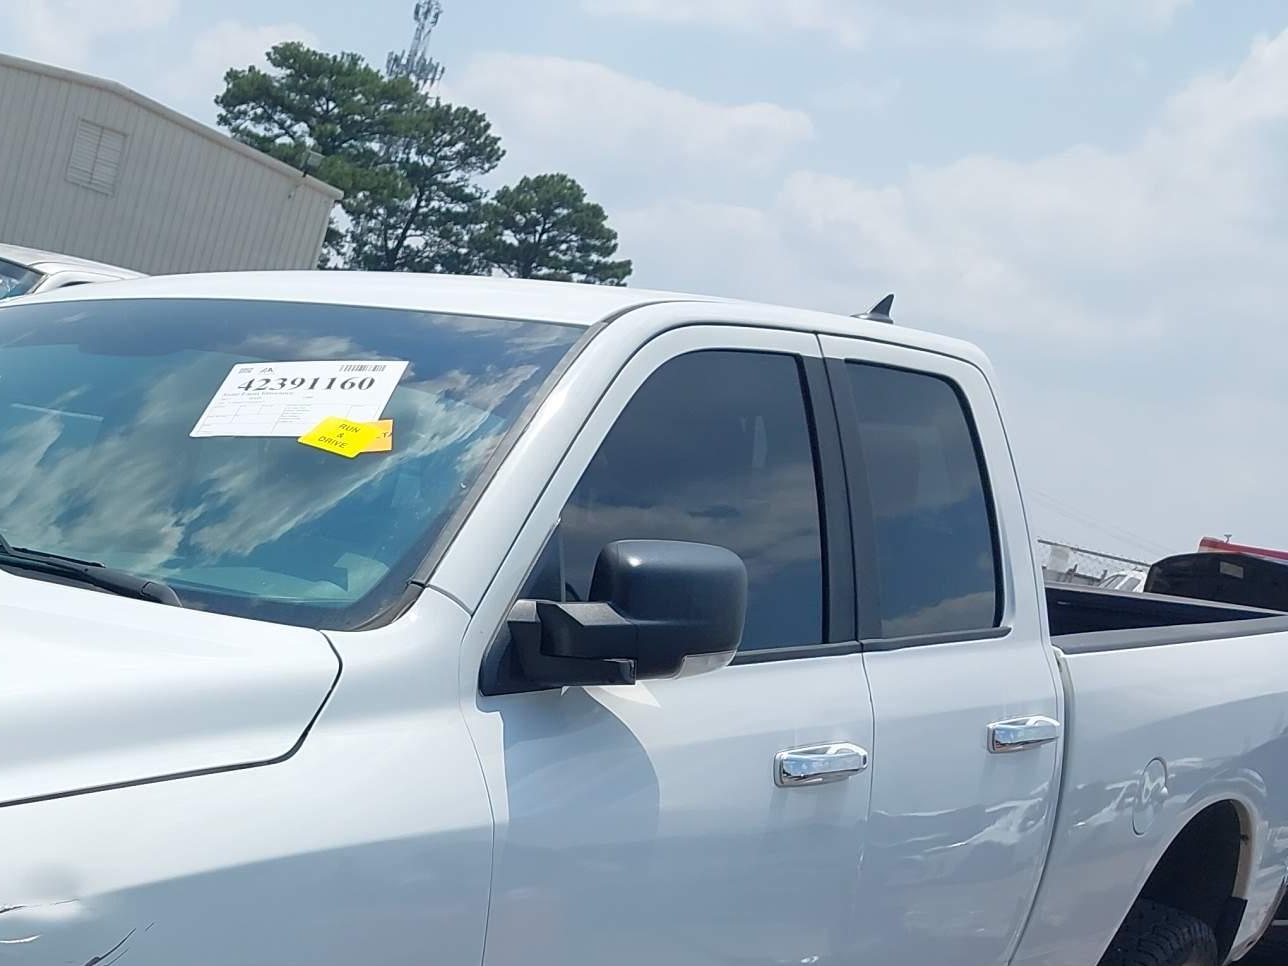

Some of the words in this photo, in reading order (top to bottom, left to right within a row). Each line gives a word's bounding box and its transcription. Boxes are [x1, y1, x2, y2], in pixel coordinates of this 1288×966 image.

[237, 376, 376, 391] 42391160
[338, 423, 361, 433] RUN
[317, 435, 348, 449] DRIVE
